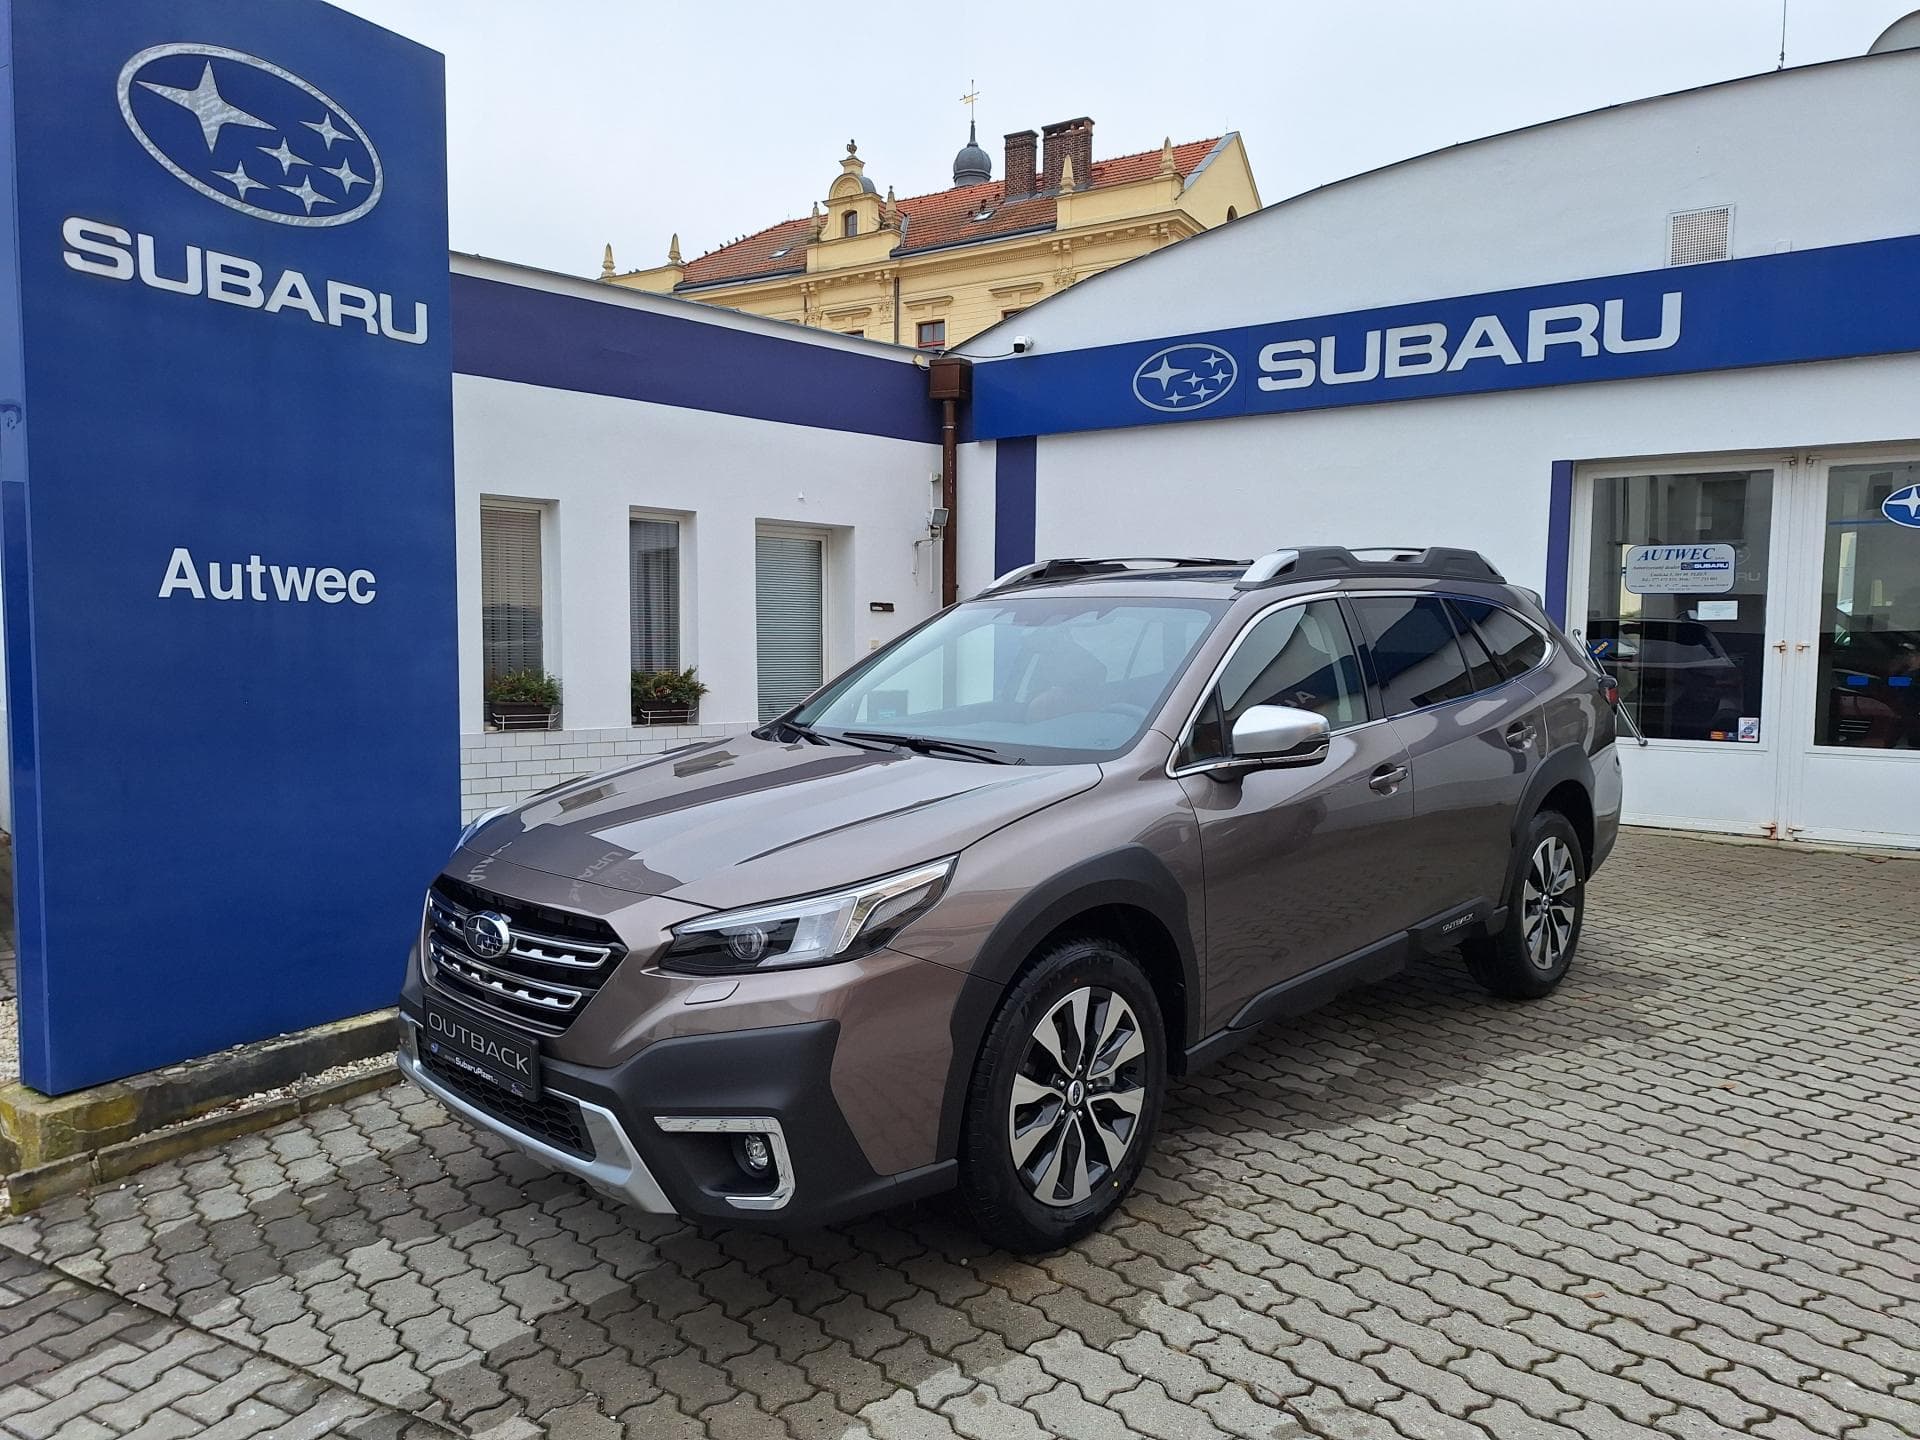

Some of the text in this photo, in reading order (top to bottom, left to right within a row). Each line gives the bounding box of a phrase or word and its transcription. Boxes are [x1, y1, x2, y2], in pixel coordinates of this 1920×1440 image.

[62, 216, 429, 346] SUBARU
[1256, 291, 1683, 393] SUBARU
[158, 547, 377, 605] Autwec
[1637, 547, 1716, 561] AUTWEC
[428, 1012, 530, 1076] OUTBACK
